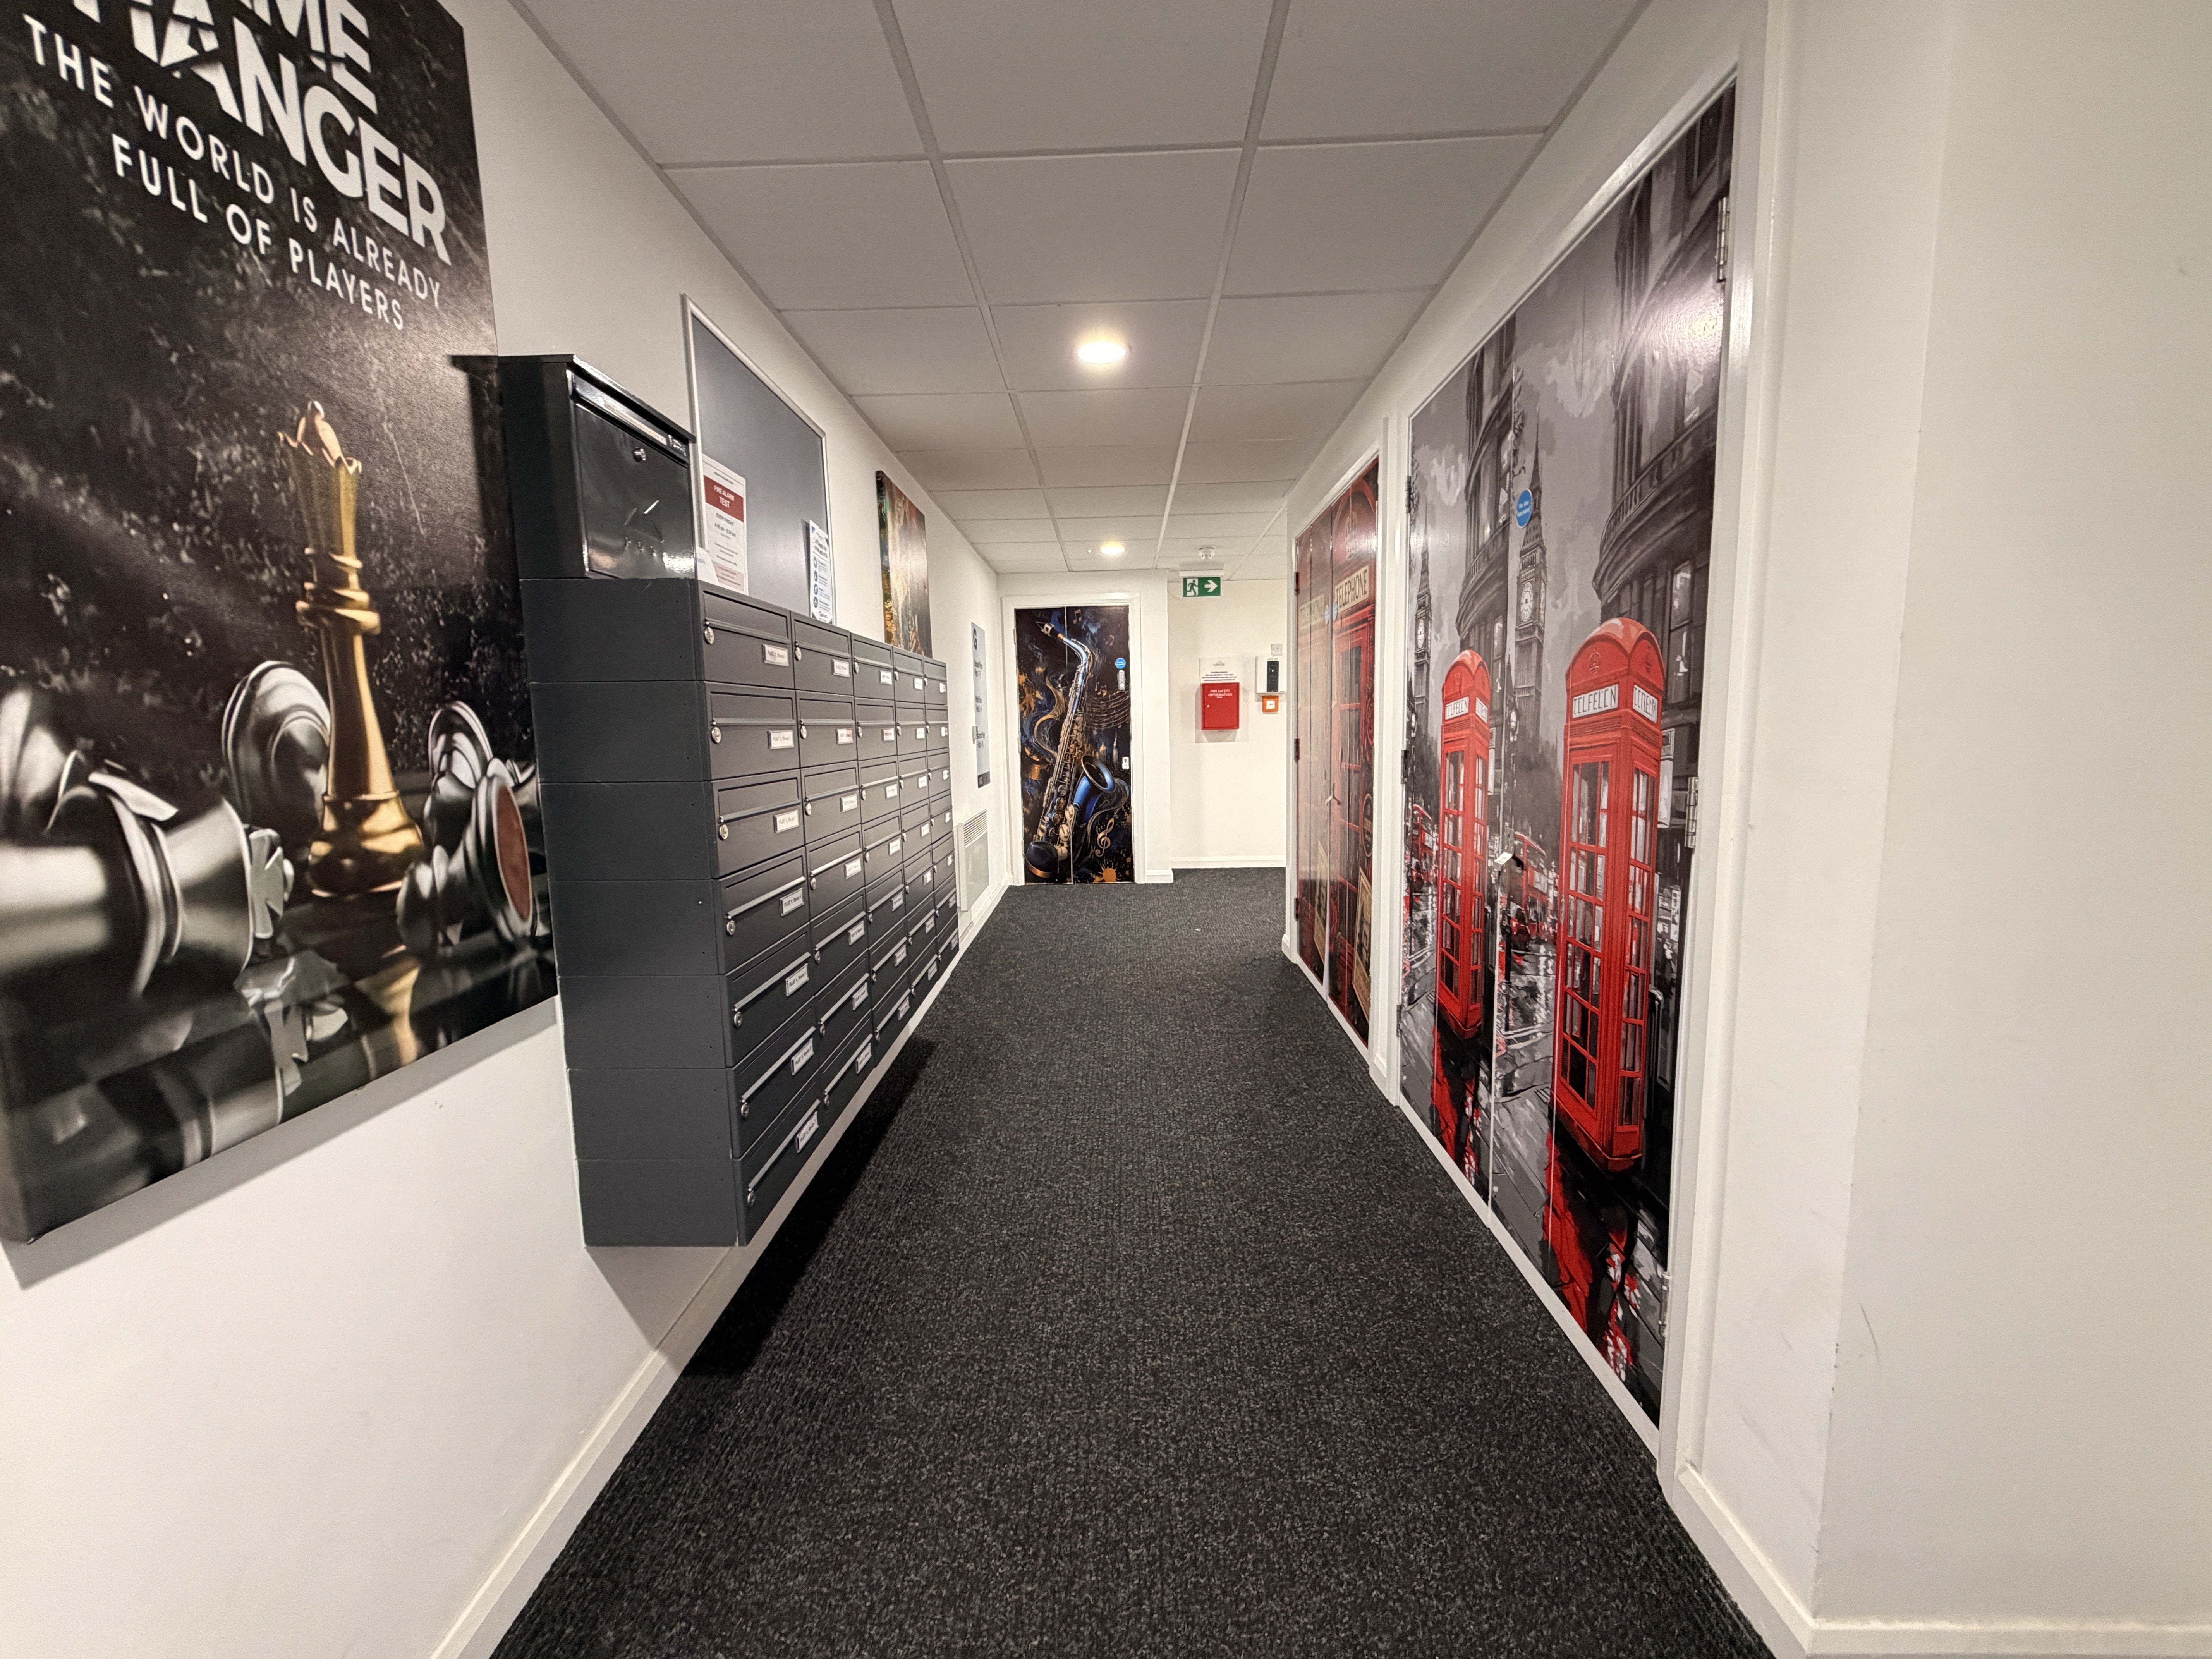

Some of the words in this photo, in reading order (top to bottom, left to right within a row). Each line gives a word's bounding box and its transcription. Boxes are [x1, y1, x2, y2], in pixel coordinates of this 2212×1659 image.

[23, 14, 114, 108] THE
[134, 86, 274, 204] WORLD
[291, 187, 317, 232] IS
[333, 217, 441, 308] ALREADY
[112, 133, 208, 223] FULL
[226, 204, 272, 255] OF
[289, 237, 404, 331] PLAYERS
[719, 496, 730, 508] TEST
[1336, 569, 1368, 608] TELEPHONE
[973, 628, 977, 650] G
